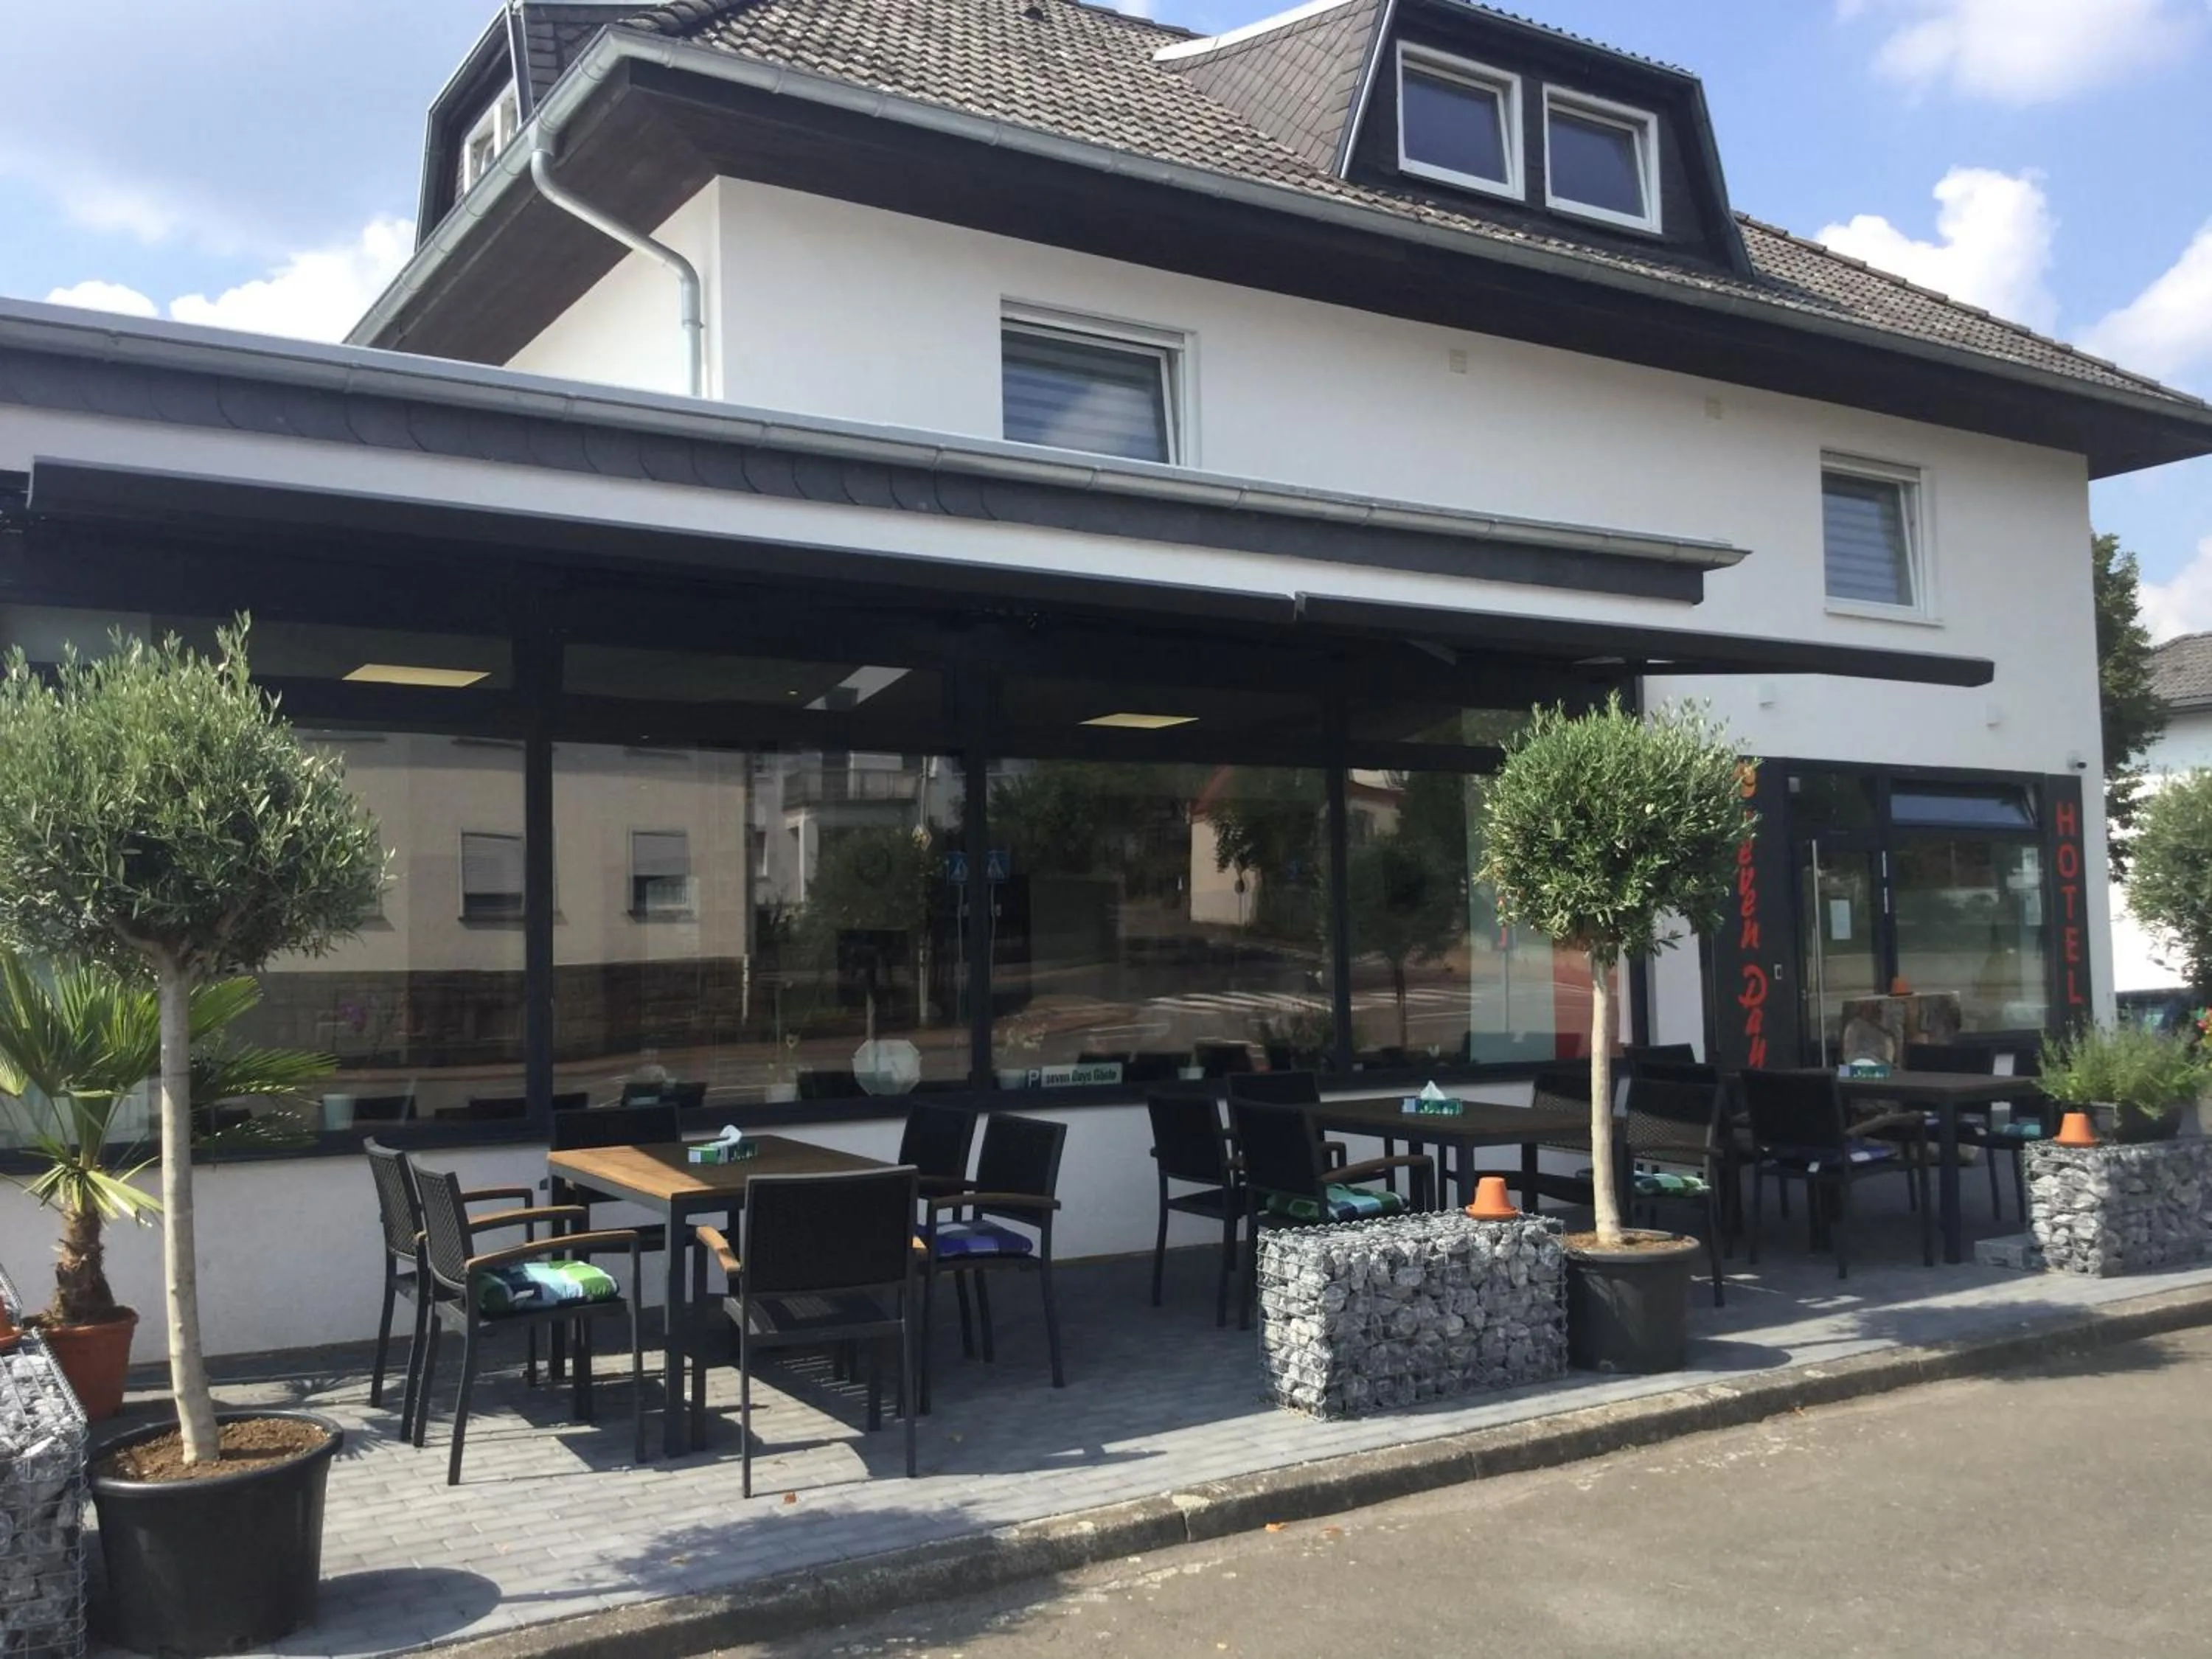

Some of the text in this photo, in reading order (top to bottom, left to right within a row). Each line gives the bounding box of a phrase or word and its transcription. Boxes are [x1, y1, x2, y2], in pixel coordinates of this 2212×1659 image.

[1736, 808, 1760, 950] even
[2056, 801, 2084, 1004] HOTEL
[1028, 1069, 1040, 1088] P
